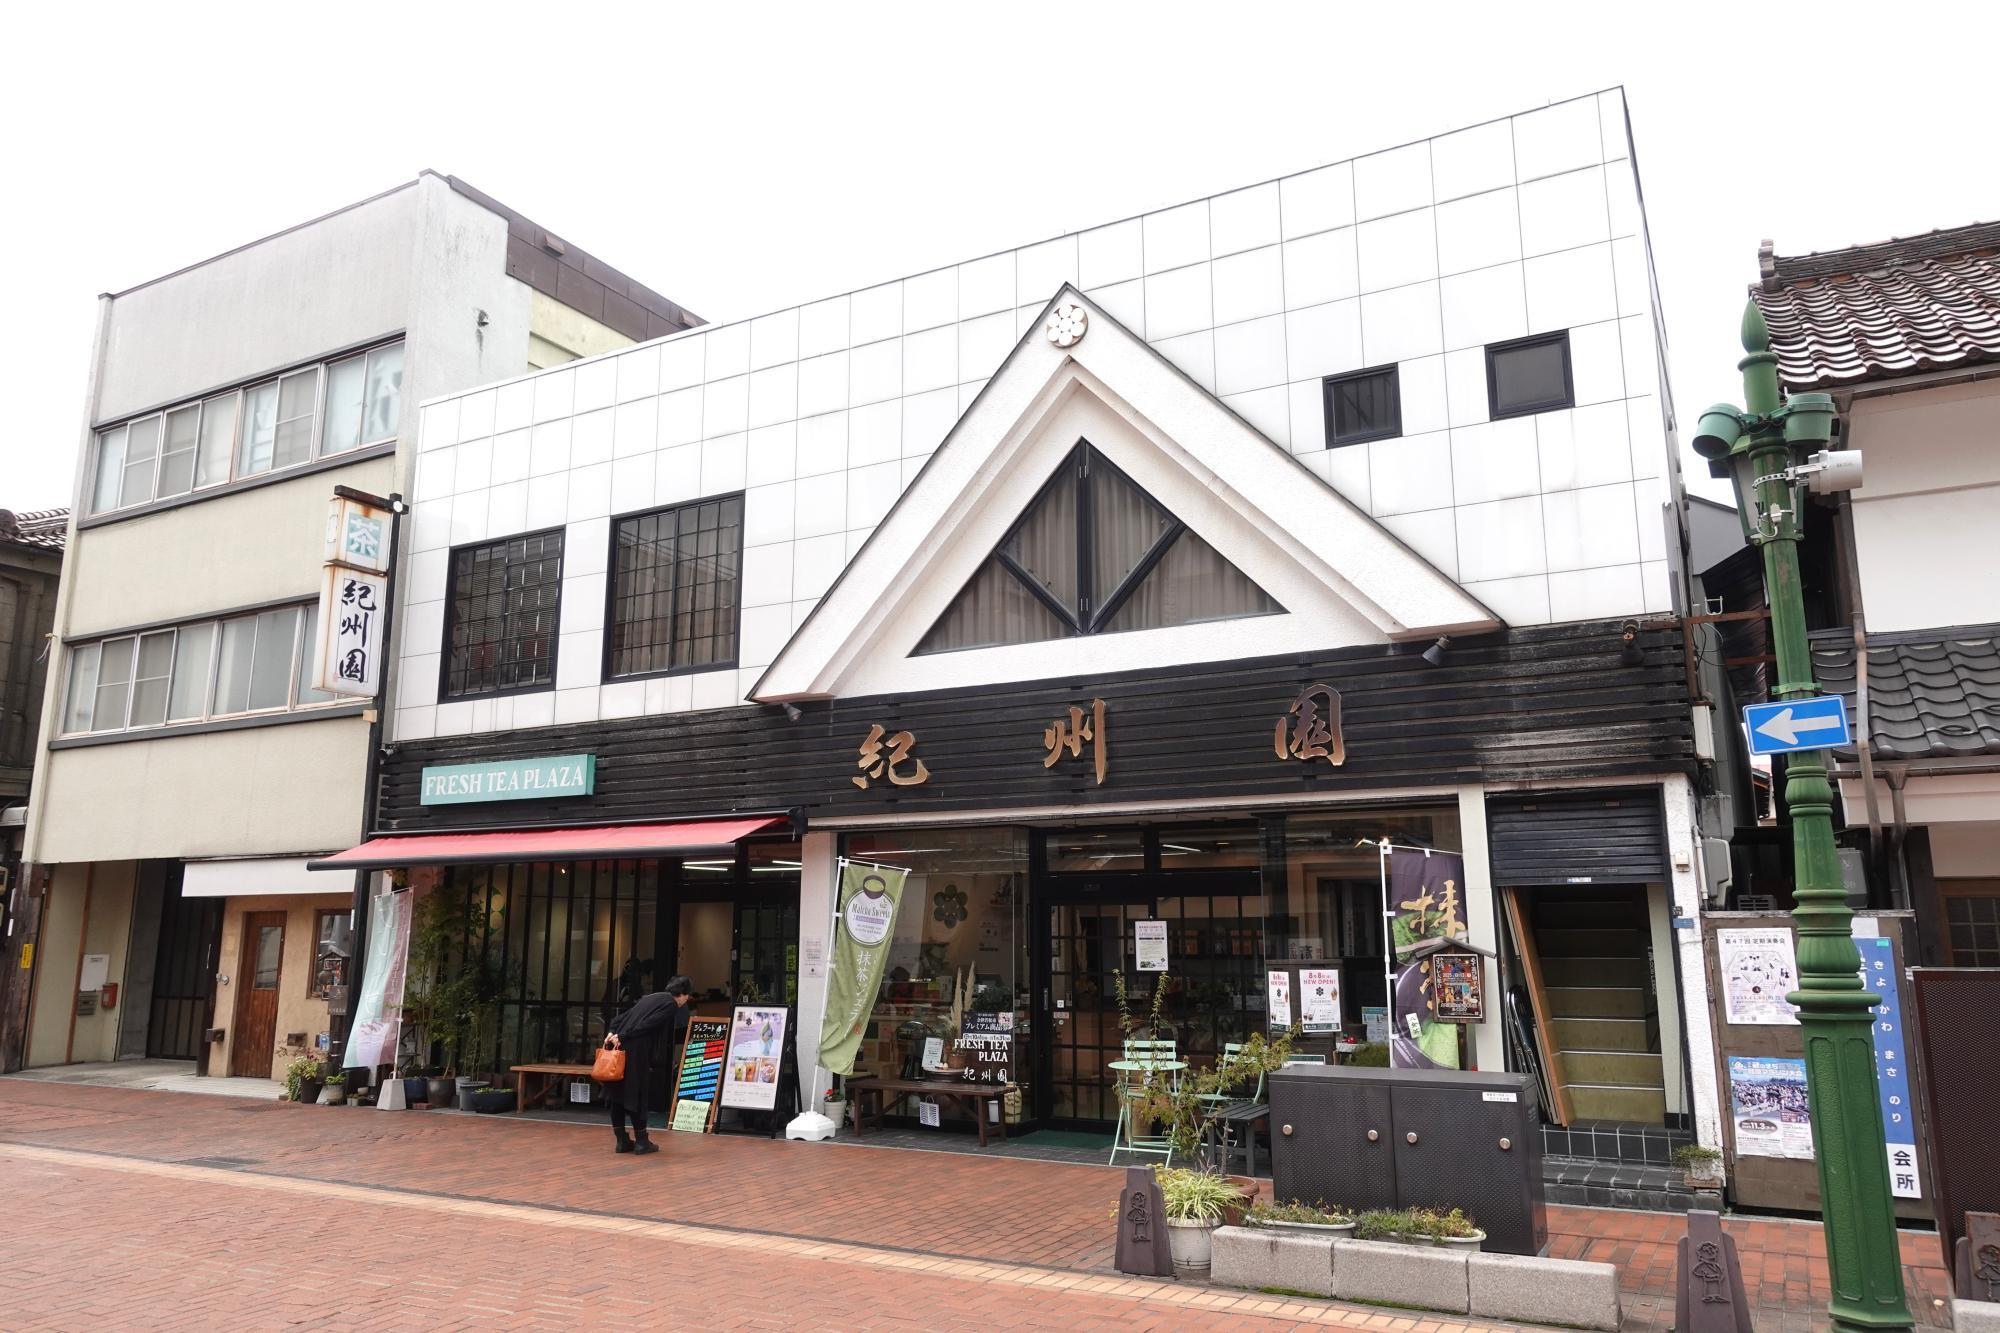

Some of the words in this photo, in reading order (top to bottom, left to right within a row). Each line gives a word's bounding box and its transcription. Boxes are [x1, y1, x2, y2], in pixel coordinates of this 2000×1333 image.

[348, 518, 379, 557] 茶
[340, 580, 376, 683] 紀州園
[425, 773, 483, 796] FRESH
[486, 770, 520, 793] TEA
[523, 765, 585, 790] PLAZA
[954, 1038, 985, 1050] FRESH
[989, 1039, 1008, 1051] TEA
[978, 1051, 1008, 1062] PLAZA
